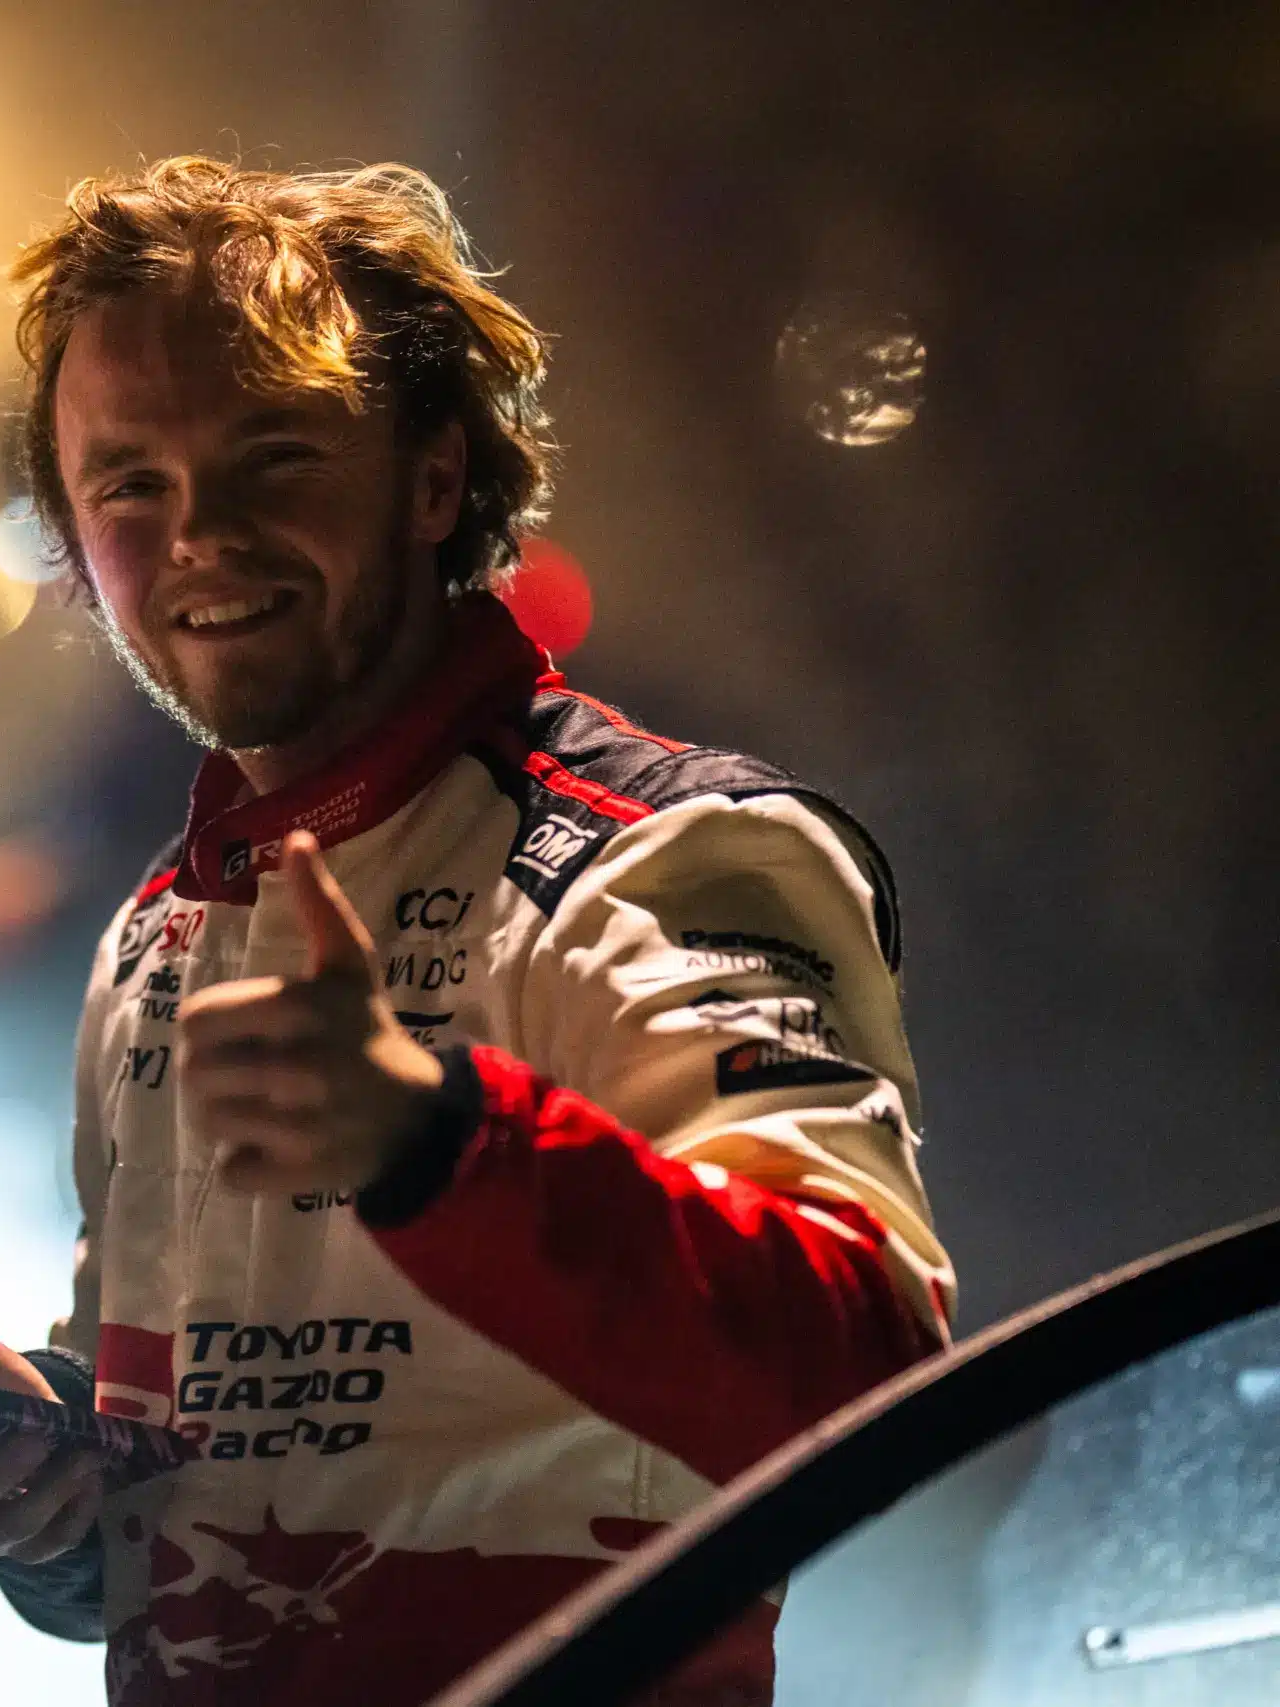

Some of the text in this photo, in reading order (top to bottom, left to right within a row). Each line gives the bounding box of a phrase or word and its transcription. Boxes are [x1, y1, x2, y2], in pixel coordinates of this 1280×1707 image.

[297, 797, 361, 832] AZOO
[185, 1318, 412, 1363] TOYOTA
[178, 1368, 385, 1413] GAZOO
